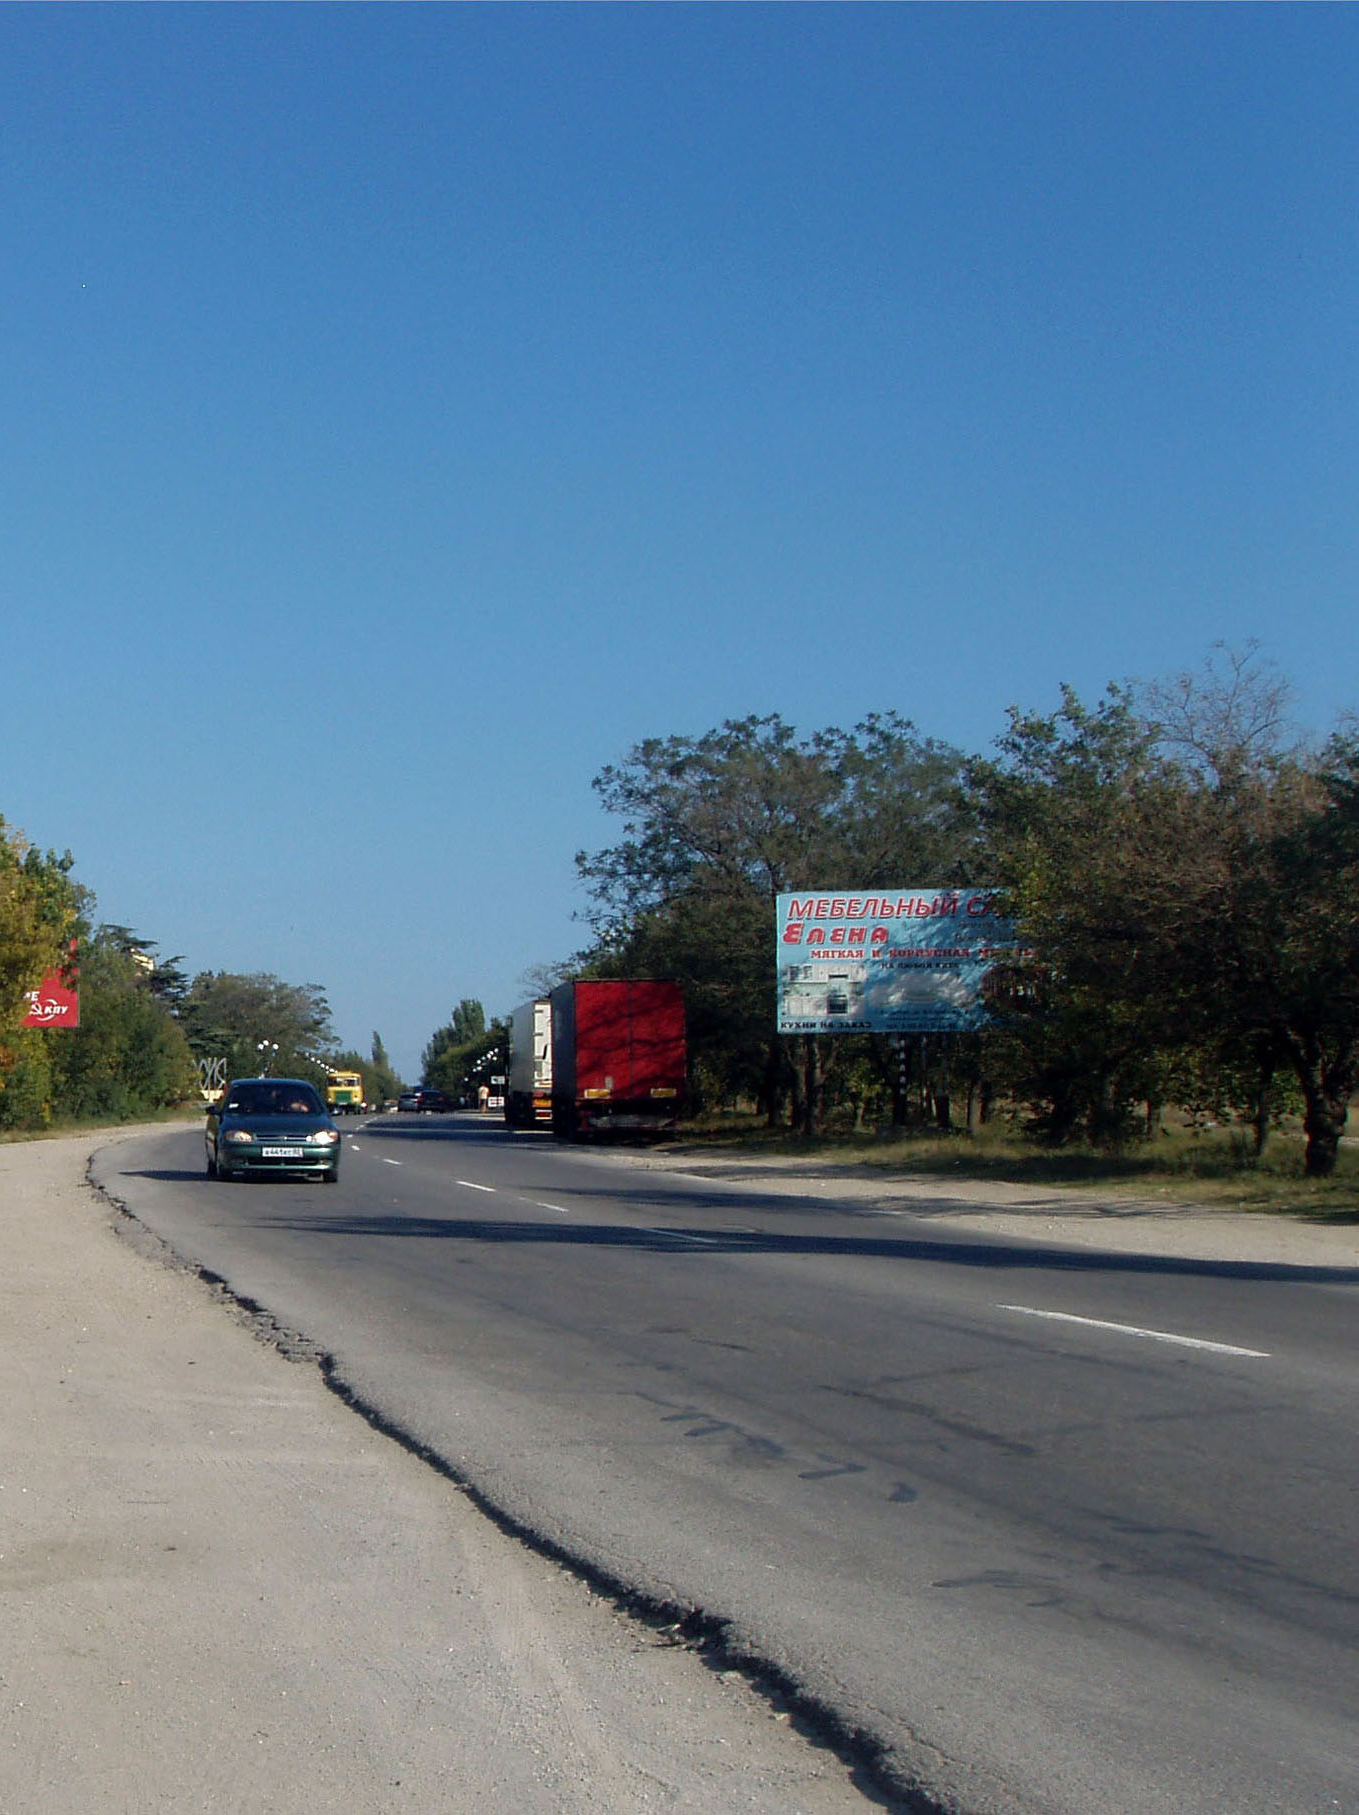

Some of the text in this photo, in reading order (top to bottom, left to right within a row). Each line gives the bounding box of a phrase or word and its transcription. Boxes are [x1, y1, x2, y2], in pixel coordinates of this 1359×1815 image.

[787, 894, 959, 919] МЕБЕЛЬНЫЙ
[810, 949, 864, 959] МЯГКАЯ
[889, 948, 970, 958] КОРПУСНАЯ
[780, 1021, 817, 1029] КУХНИ
[820, 1021, 834, 1029] НА
